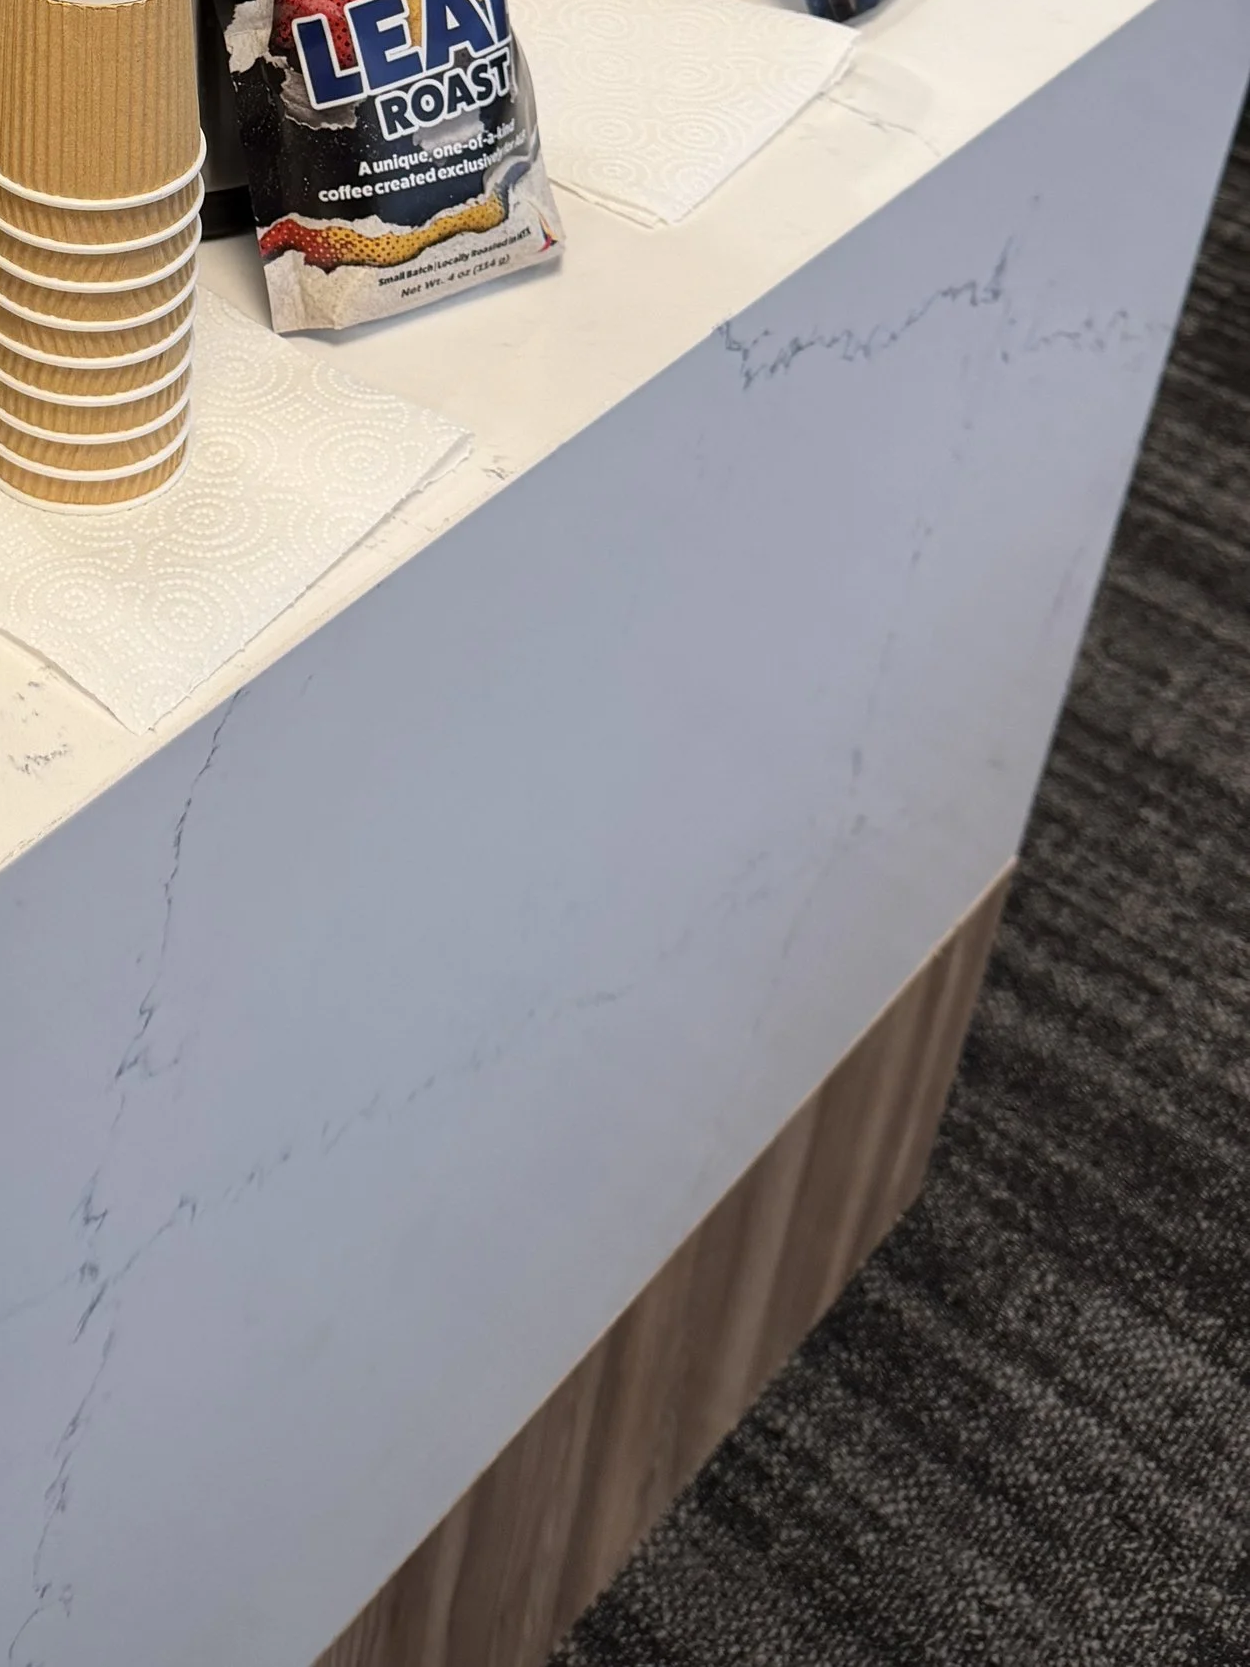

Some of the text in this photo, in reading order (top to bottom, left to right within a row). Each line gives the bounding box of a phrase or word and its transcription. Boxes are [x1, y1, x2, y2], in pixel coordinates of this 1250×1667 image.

[375, 47, 511, 142] ROAST
[318, 181, 373, 203] coffee
[374, 168, 437, 196] created
[358, 160, 373, 176] A
[378, 270, 406, 287] Small
[406, 262, 434, 279] Batch
[437, 252, 470, 270] Locally
[400, 284, 422, 299] Net
[447, 272, 455, 282] 4
